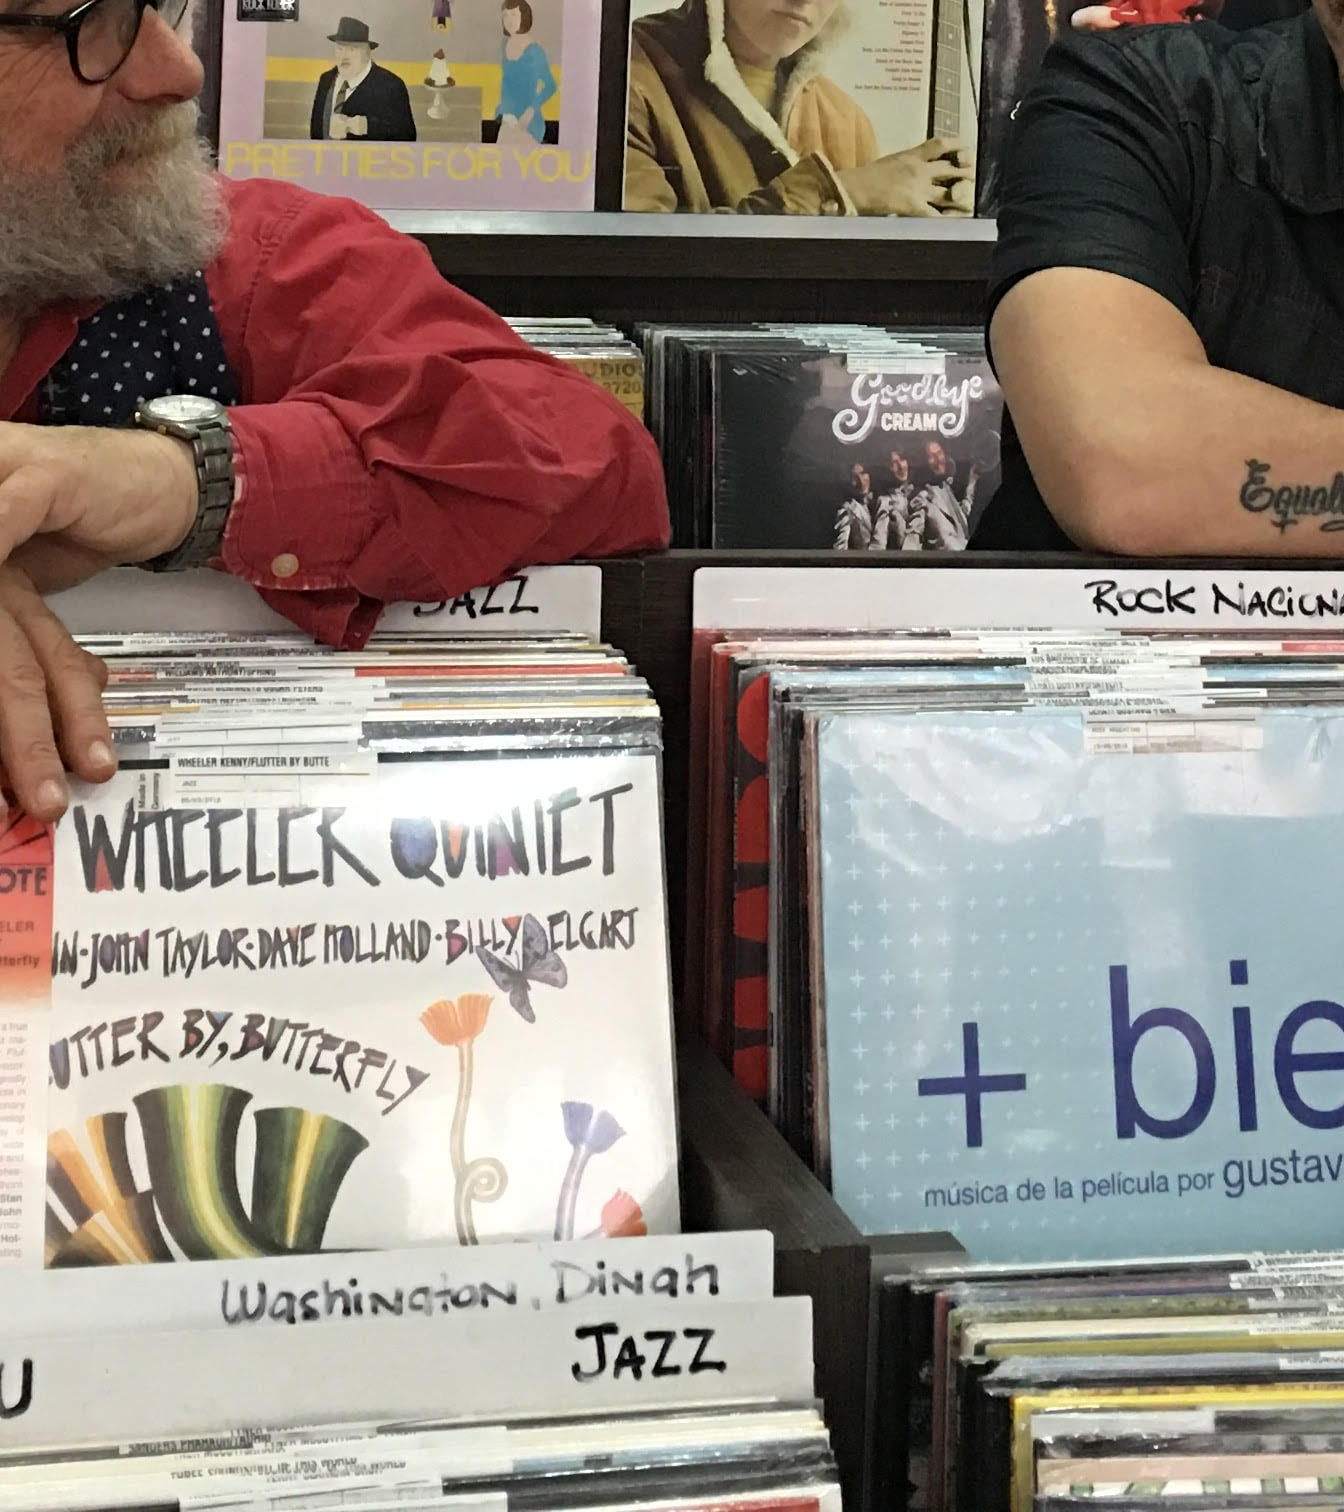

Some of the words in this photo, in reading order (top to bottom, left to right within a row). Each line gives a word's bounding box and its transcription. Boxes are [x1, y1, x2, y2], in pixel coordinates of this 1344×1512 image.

[225, 142, 416, 182] PRETTIES
[423, 148, 504, 182] FOR
[507, 151, 593, 185] YOU
[832, 373, 984, 445] Goodbye
[881, 413, 938, 433] CREAM
[177, 756, 217, 769] WHEELER
[219, 756, 287, 769] KENNY/FLUTTER
[289, 756, 301, 768] BY
[302, 755, 330, 768] BUTTE
[73, 798, 381, 894] WHEELER
[48, 1009, 171, 1090] UTTER
[229, 1012, 431, 1115] BUTTERFLY
[0, 1193, 23, 1204] Stan
[924, 1177, 1009, 1210] música
[1016, 1175, 1047, 1204] de
[1053, 1173, 1075, 1201] la
[1081, 1166, 1170, 1205] película
[1177, 1167, 1216, 1199] por
[571, 1321, 727, 1383] JAZZ
